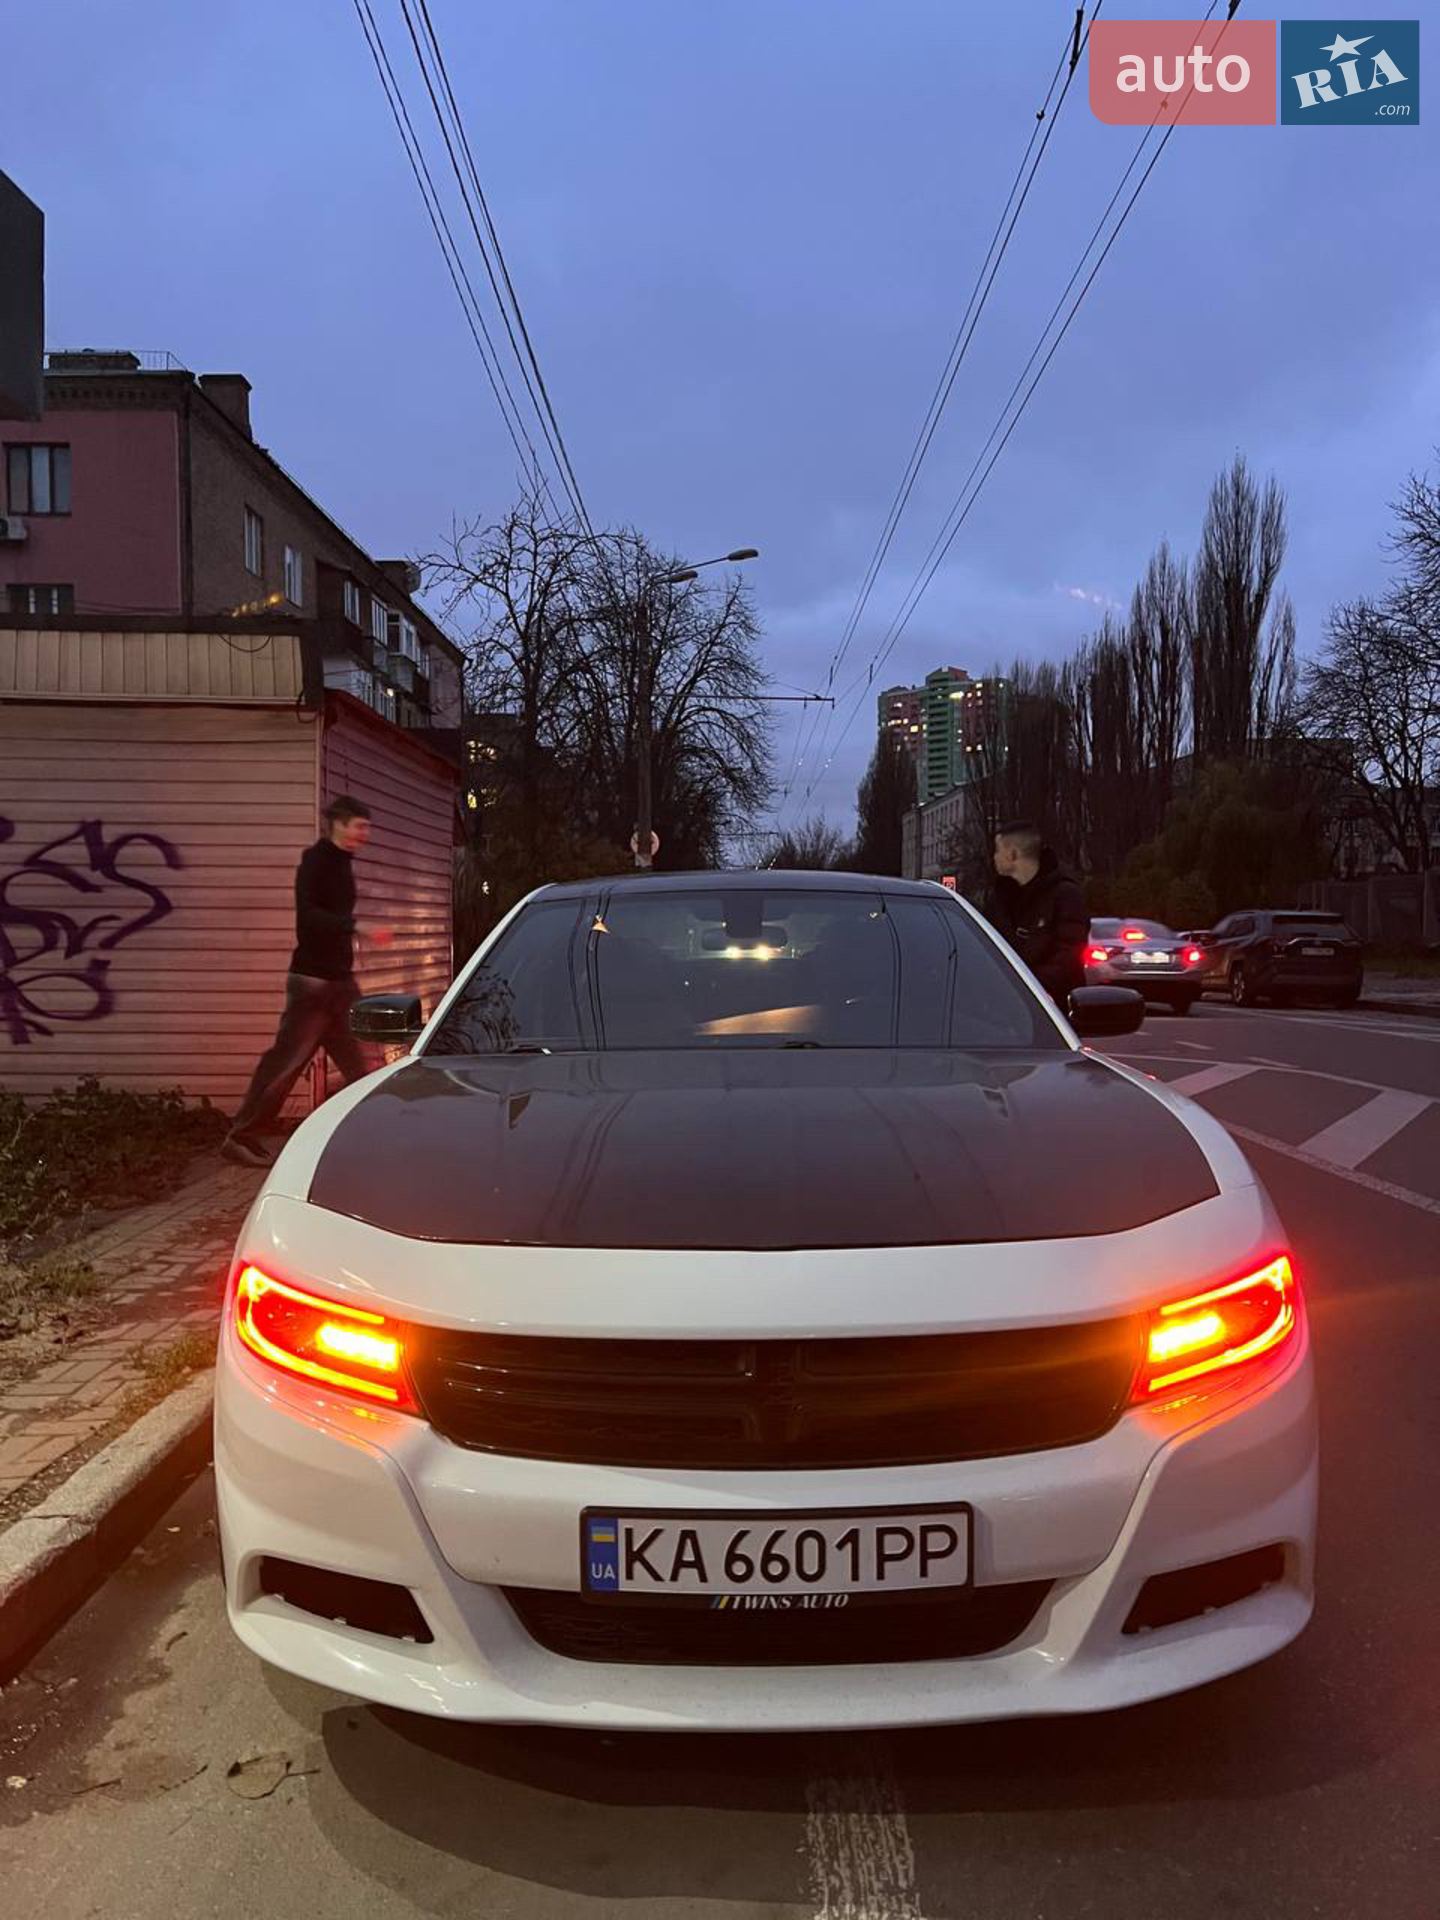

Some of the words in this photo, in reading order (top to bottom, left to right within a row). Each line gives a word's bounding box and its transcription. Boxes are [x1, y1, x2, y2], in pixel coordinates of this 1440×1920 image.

[625, 1527, 708, 1583] KA
[724, 1528, 859, 1584] 6601
[876, 1524, 958, 1581] PP
[591, 1562, 616, 1579] UA
[732, 1595, 792, 1609] TWINS
[797, 1594, 849, 1609] AUTO
